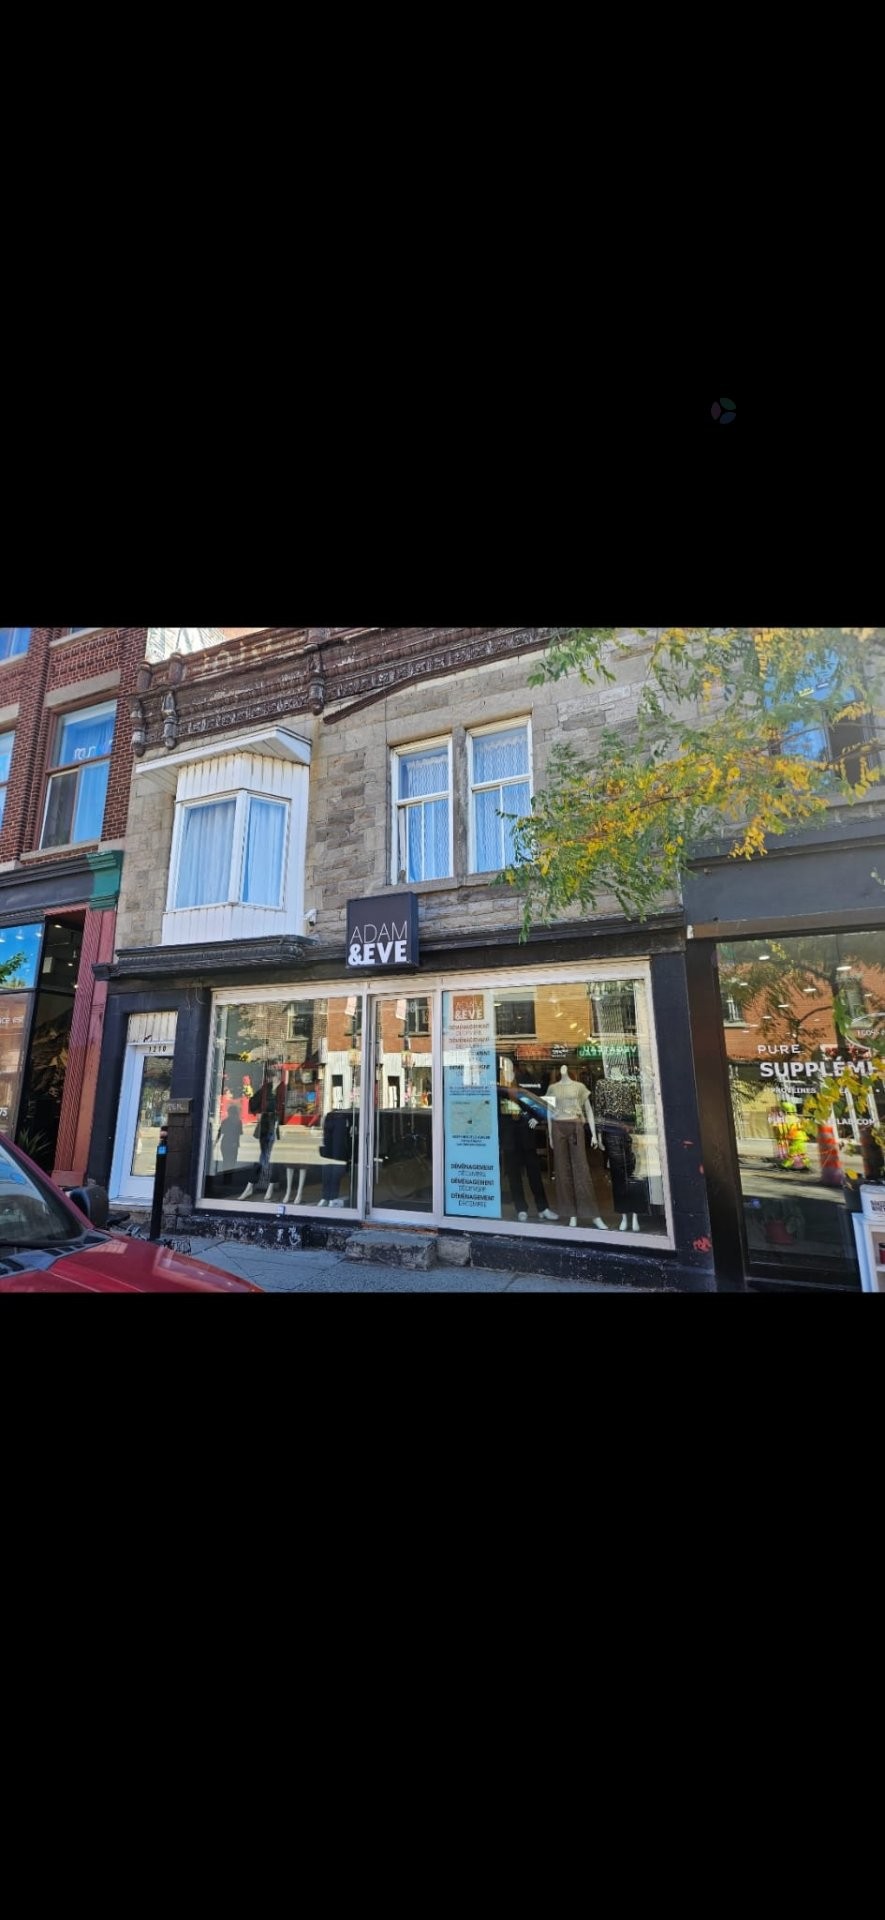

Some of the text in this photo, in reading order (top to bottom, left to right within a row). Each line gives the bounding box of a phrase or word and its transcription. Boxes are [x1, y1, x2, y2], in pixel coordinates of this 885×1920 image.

[349, 920, 408, 944] ADAM
[348, 939, 407, 966] &EVE
[149, 1045, 167, 1053] 1210
[757, 1044, 800, 1055] PURE
